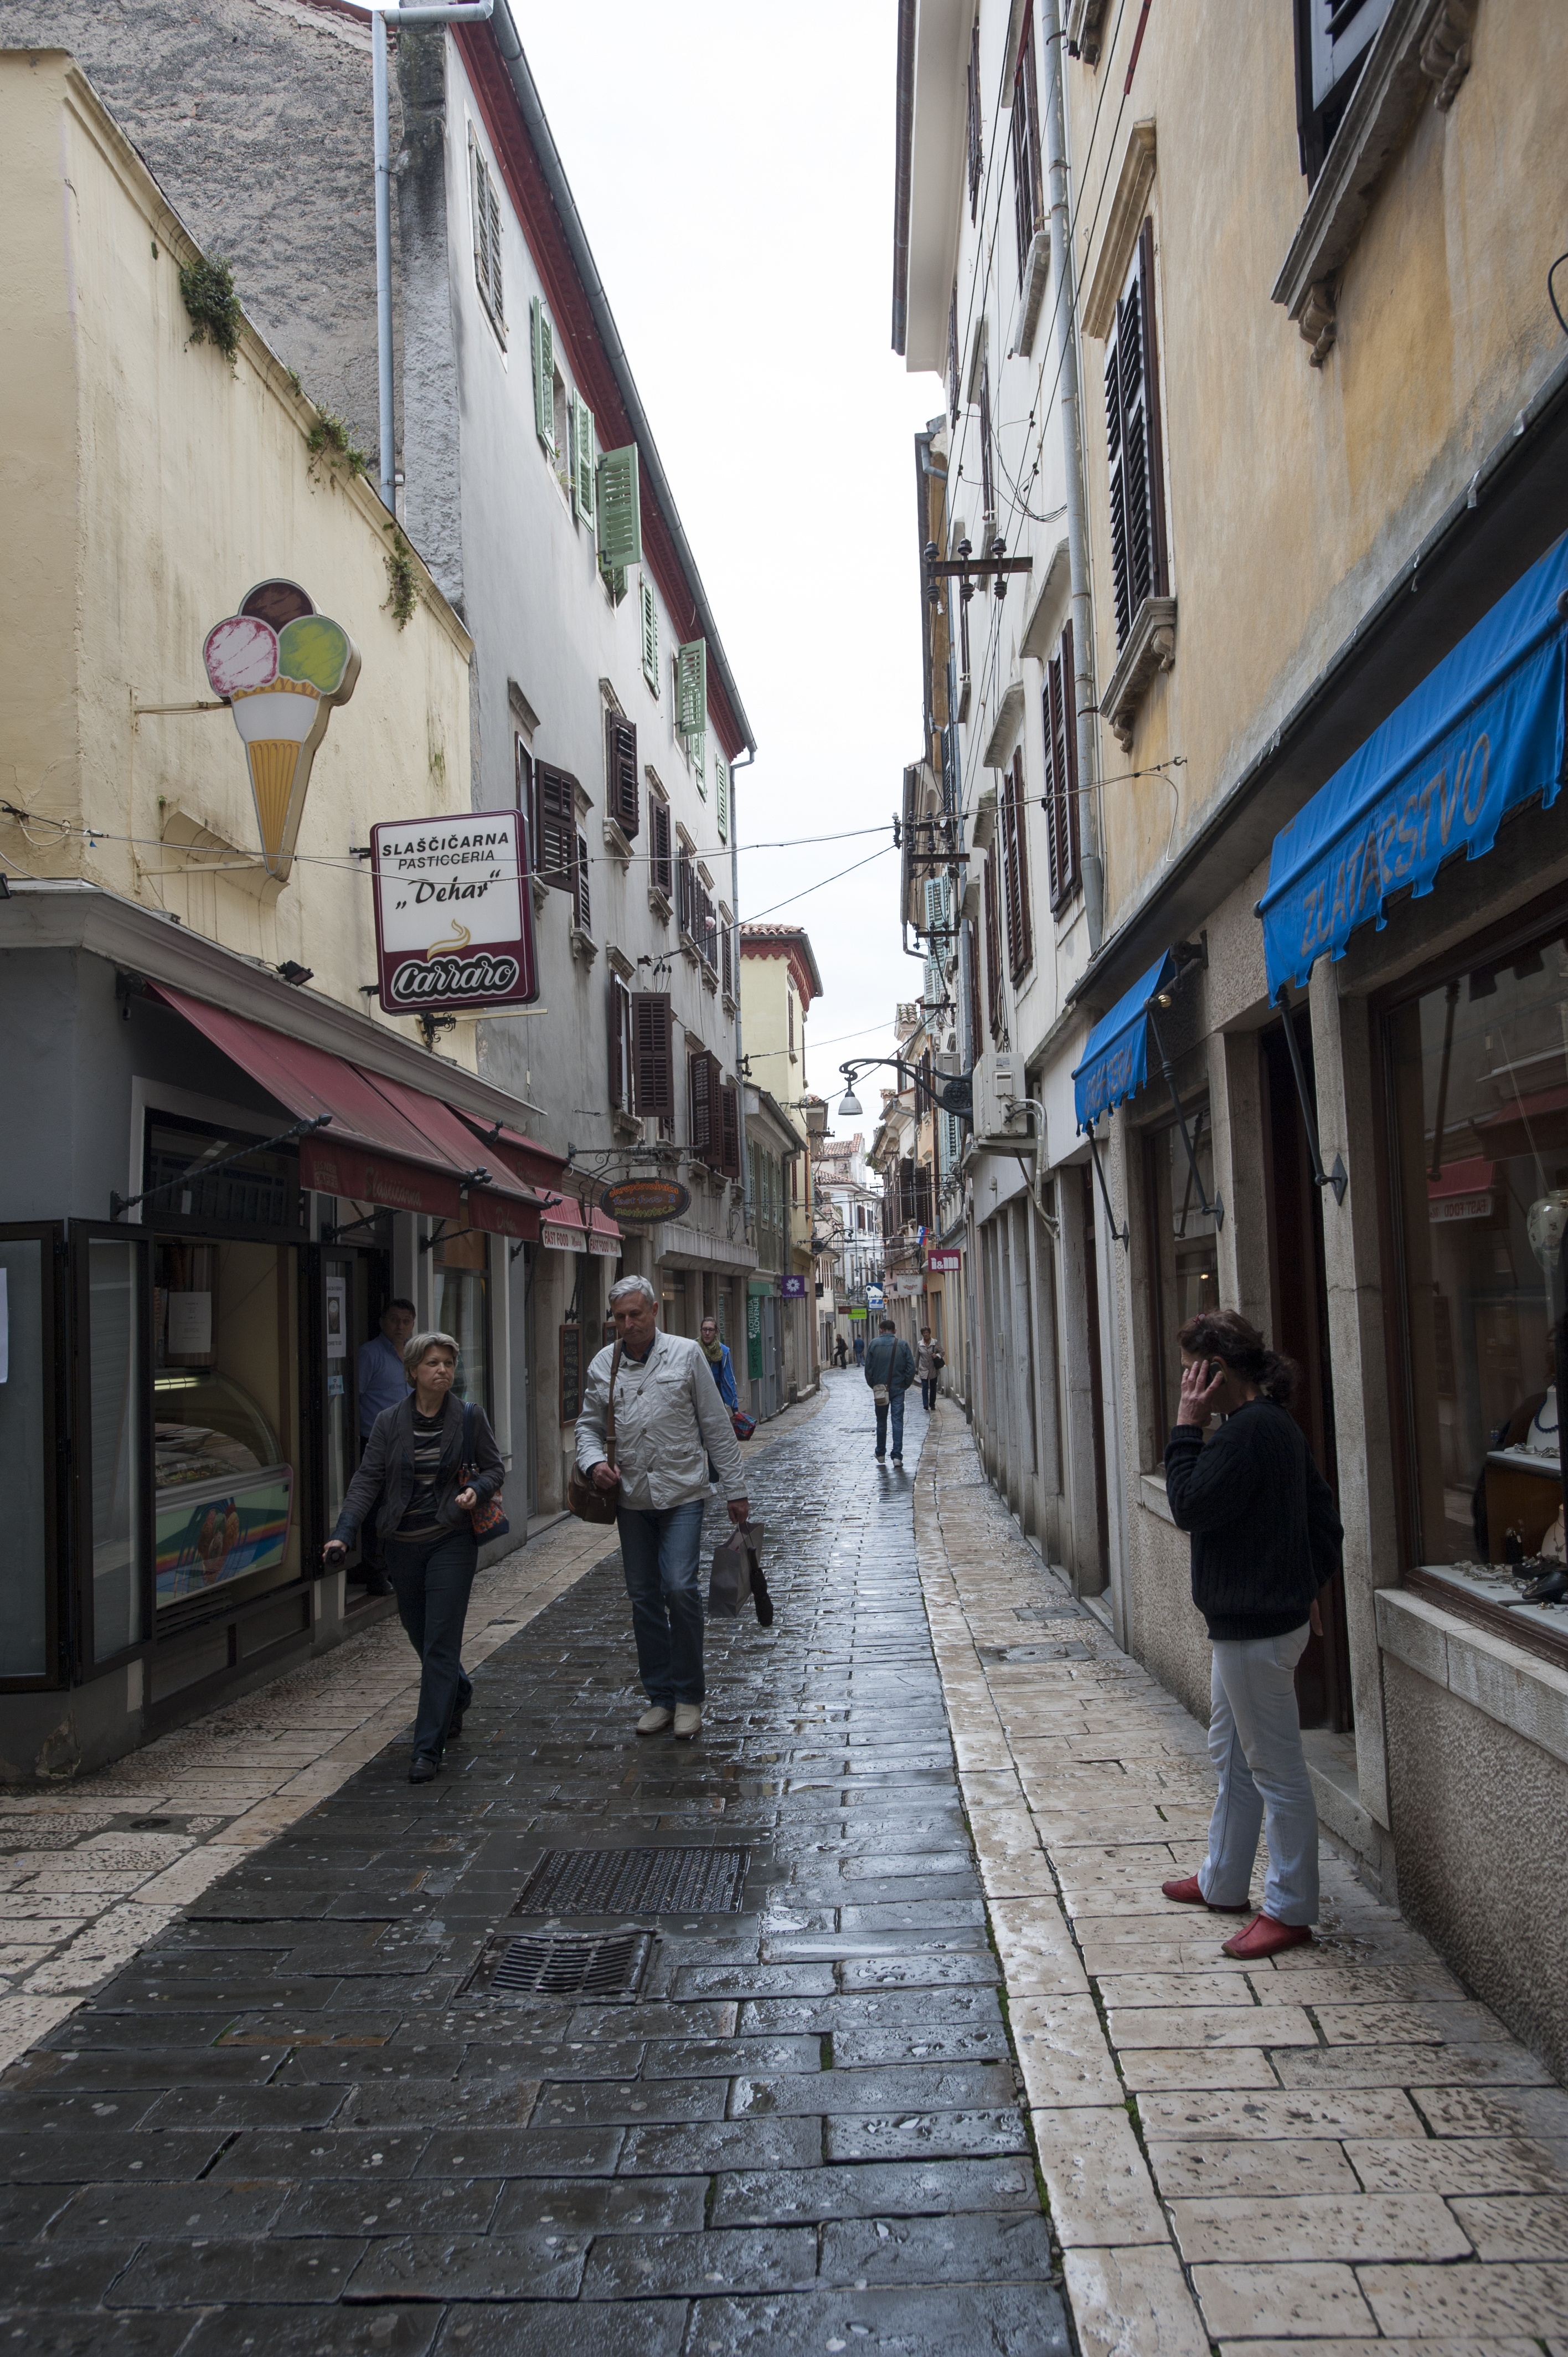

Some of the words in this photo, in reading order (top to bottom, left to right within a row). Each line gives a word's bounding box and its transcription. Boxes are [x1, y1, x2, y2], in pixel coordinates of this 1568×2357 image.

[382, 832, 509, 857] SLAŠČIČARNA
[1301, 733, 1490, 958] ZLATARSTVO
[398, 850, 495, 870] PASTICCERIA
[394, 959, 517, 996] Carraro
[613, 1195, 636, 1205] fast
[637, 1195, 662, 1204] food
[668, 1194, 675, 1203] 2
[614, 1205, 676, 1217] paninoteca
[544, 1230, 556, 1246] FAST
[557, 1232, 569, 1247] FOOD
[590, 1238, 599, 1251] FAST
[599, 1240, 609, 1253] FOOD
